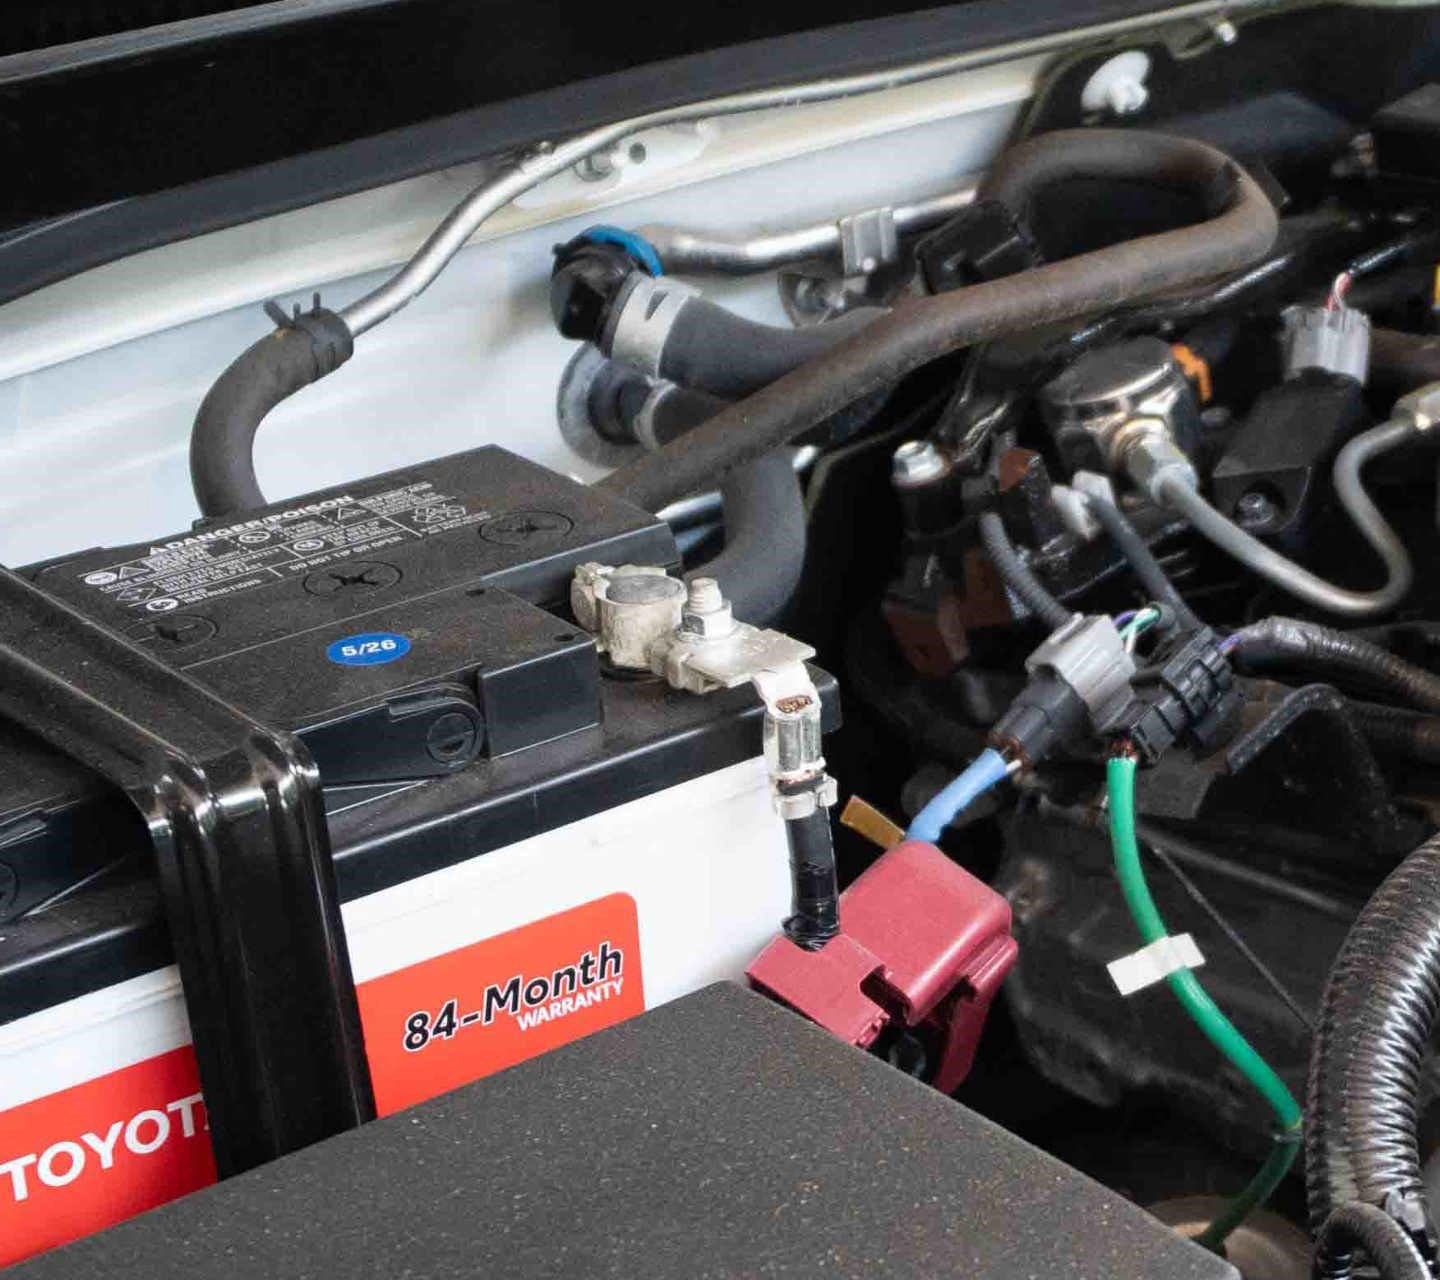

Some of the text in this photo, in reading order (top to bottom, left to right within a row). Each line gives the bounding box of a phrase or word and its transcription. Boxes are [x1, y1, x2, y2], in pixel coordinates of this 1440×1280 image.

[164, 495, 354, 549] DANGER/POISON
[341, 639, 397, 657] 5/26
[403, 940, 624, 1052] 84-Month
[515, 976, 625, 1032] WARRANTY
